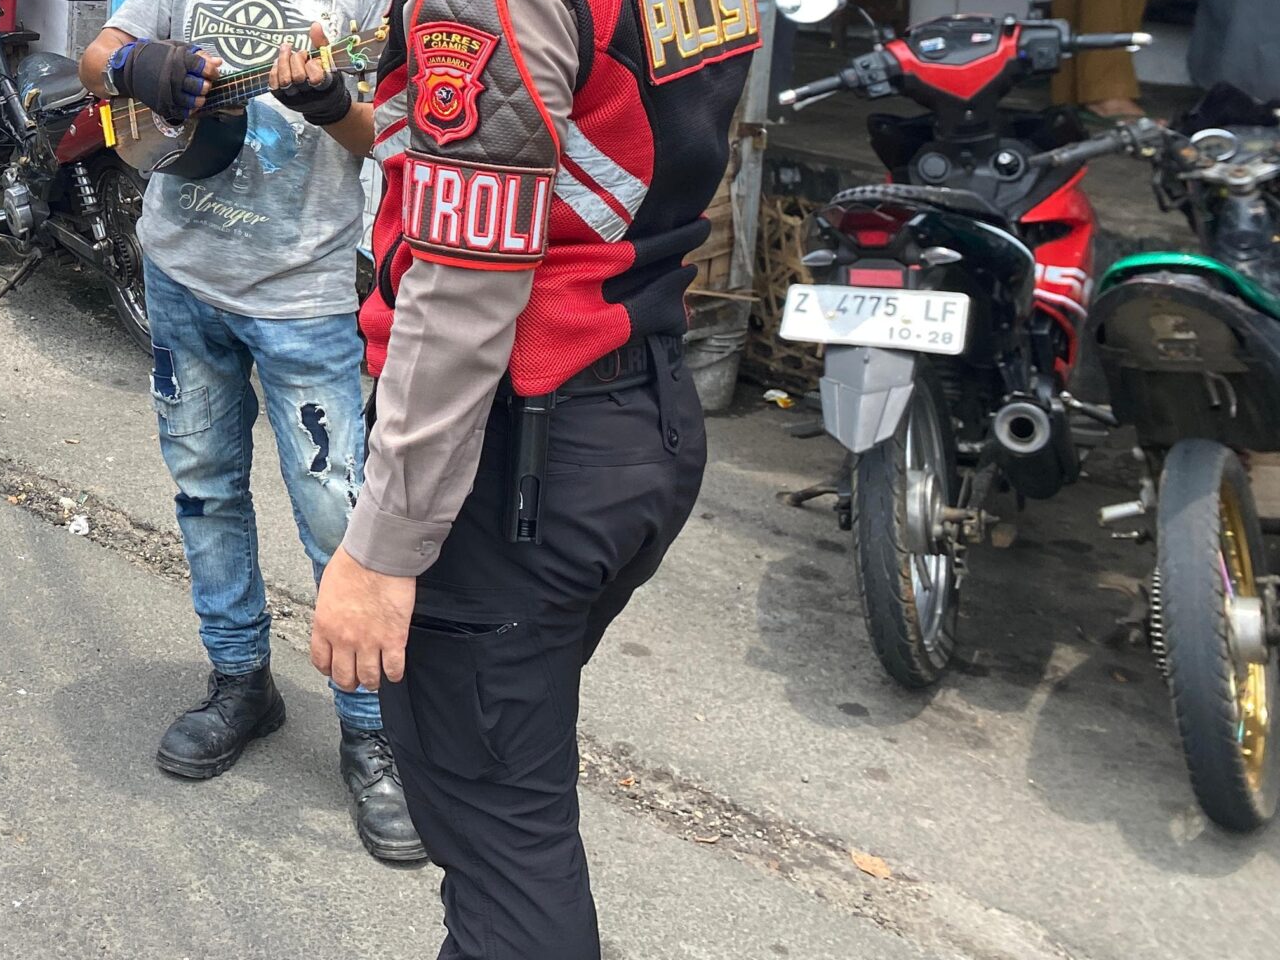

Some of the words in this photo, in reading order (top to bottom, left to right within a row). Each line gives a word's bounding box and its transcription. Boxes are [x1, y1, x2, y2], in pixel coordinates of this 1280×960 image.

[198, 13, 308, 52] Volkswagen
[423, 32, 481, 50] POLRES
[431, 41, 468, 53] CIAMIS
[428, 56, 446, 64] JAWA
[446, 56, 470, 69] BARAT
[180, 182, 270, 228] Stronger
[794, 293, 809, 313] Z
[836, 294, 899, 318] 4775
[924, 300, 957, 323] LF
